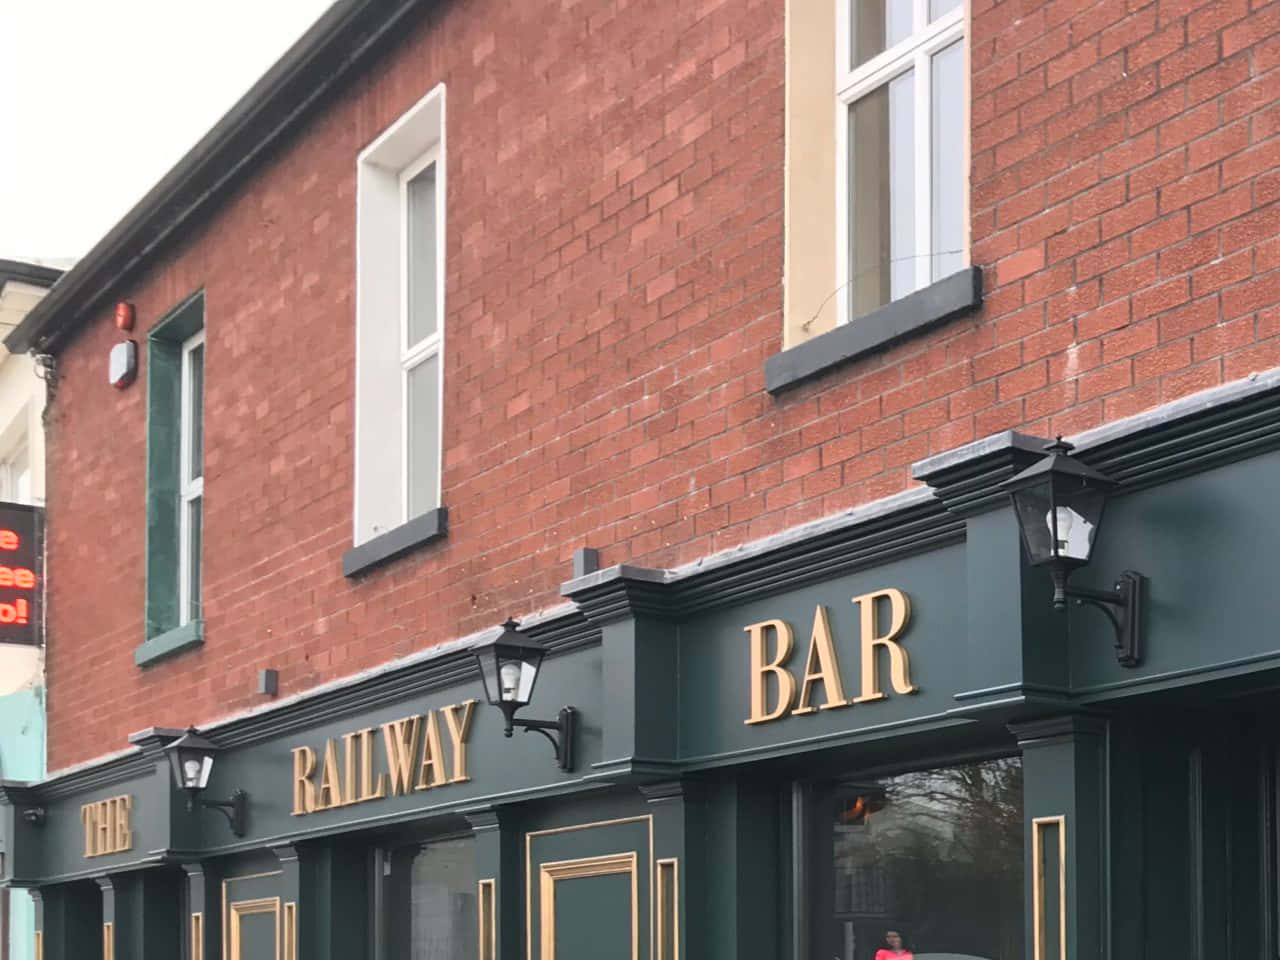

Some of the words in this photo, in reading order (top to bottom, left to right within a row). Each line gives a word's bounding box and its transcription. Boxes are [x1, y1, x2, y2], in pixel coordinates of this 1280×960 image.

[81, 794, 133, 858] THE
[290, 699, 480, 816] RAILWAY
[743, 587, 919, 725] BAR
